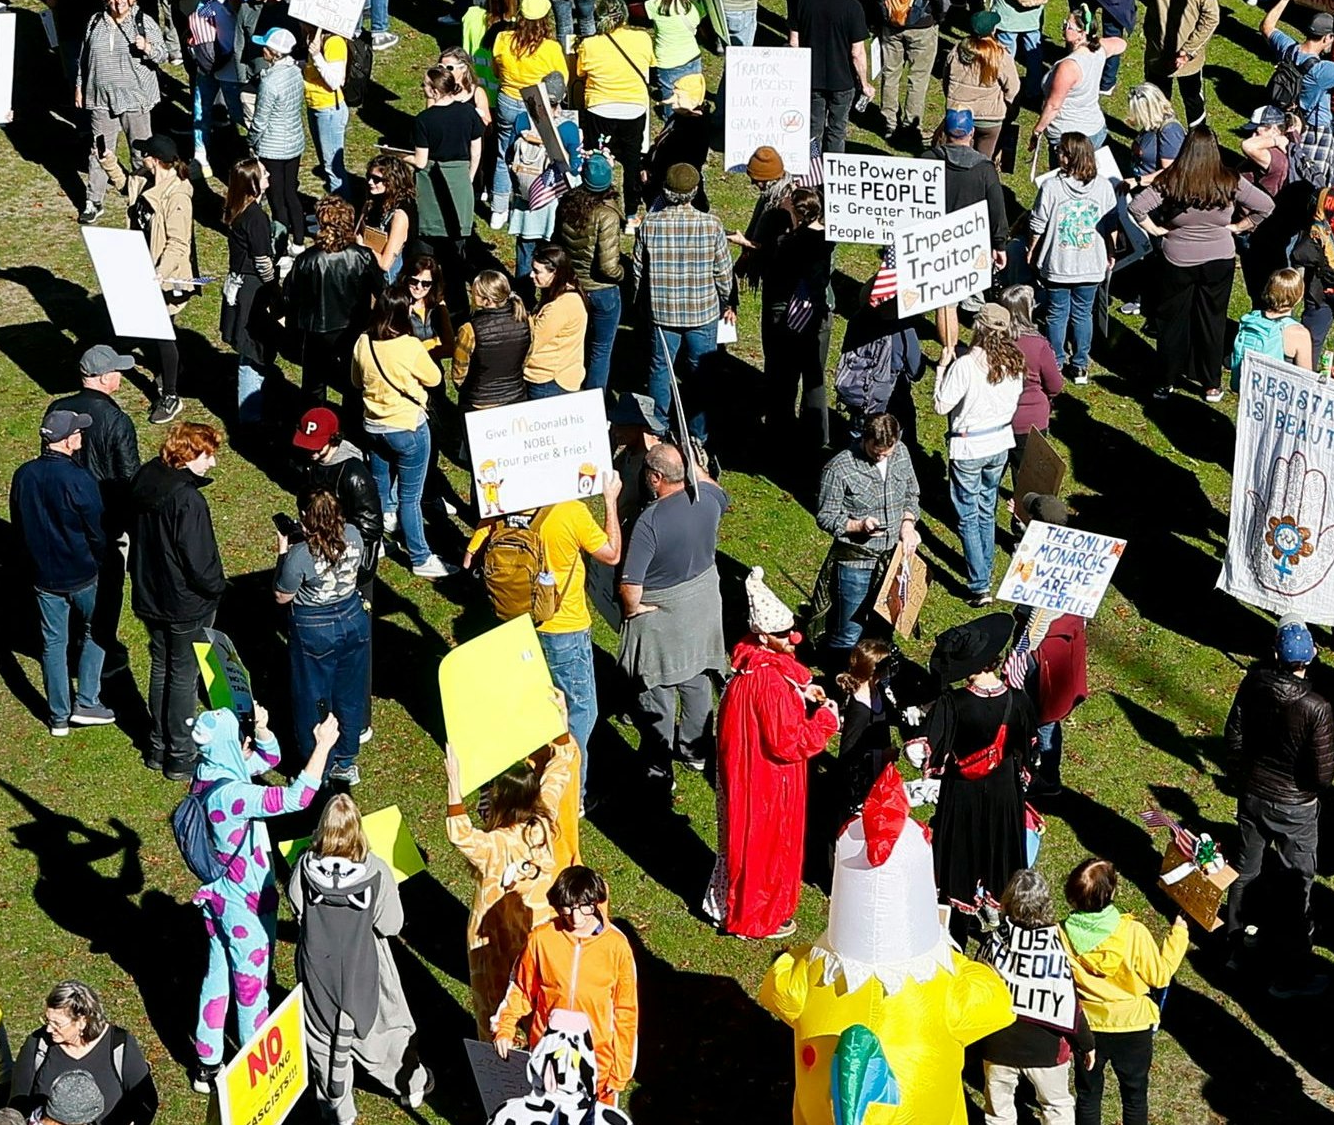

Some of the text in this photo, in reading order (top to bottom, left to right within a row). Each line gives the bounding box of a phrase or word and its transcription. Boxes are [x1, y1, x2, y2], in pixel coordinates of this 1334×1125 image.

[827, 159, 943, 183] The Power of
[827, 181, 936, 205] THE PEOPLE
[829, 202, 942, 220] is Greater Than
[875, 217, 895, 227] The
[829, 225, 895, 240] People in
[901, 211, 986, 256] Impeach
[907, 243, 982, 280] Traitor
[916, 270, 979, 303] Trump
[1245, 398, 1265, 421] IS
[1045, 526, 1113, 554] THE ONLY
[1034, 543, 1108, 574] MONARCHS
[1040, 575, 1072, 594] ARE
[1011, 584, 1097, 616] BUTTERFLIES
[246, 1026, 283, 1089] NO
